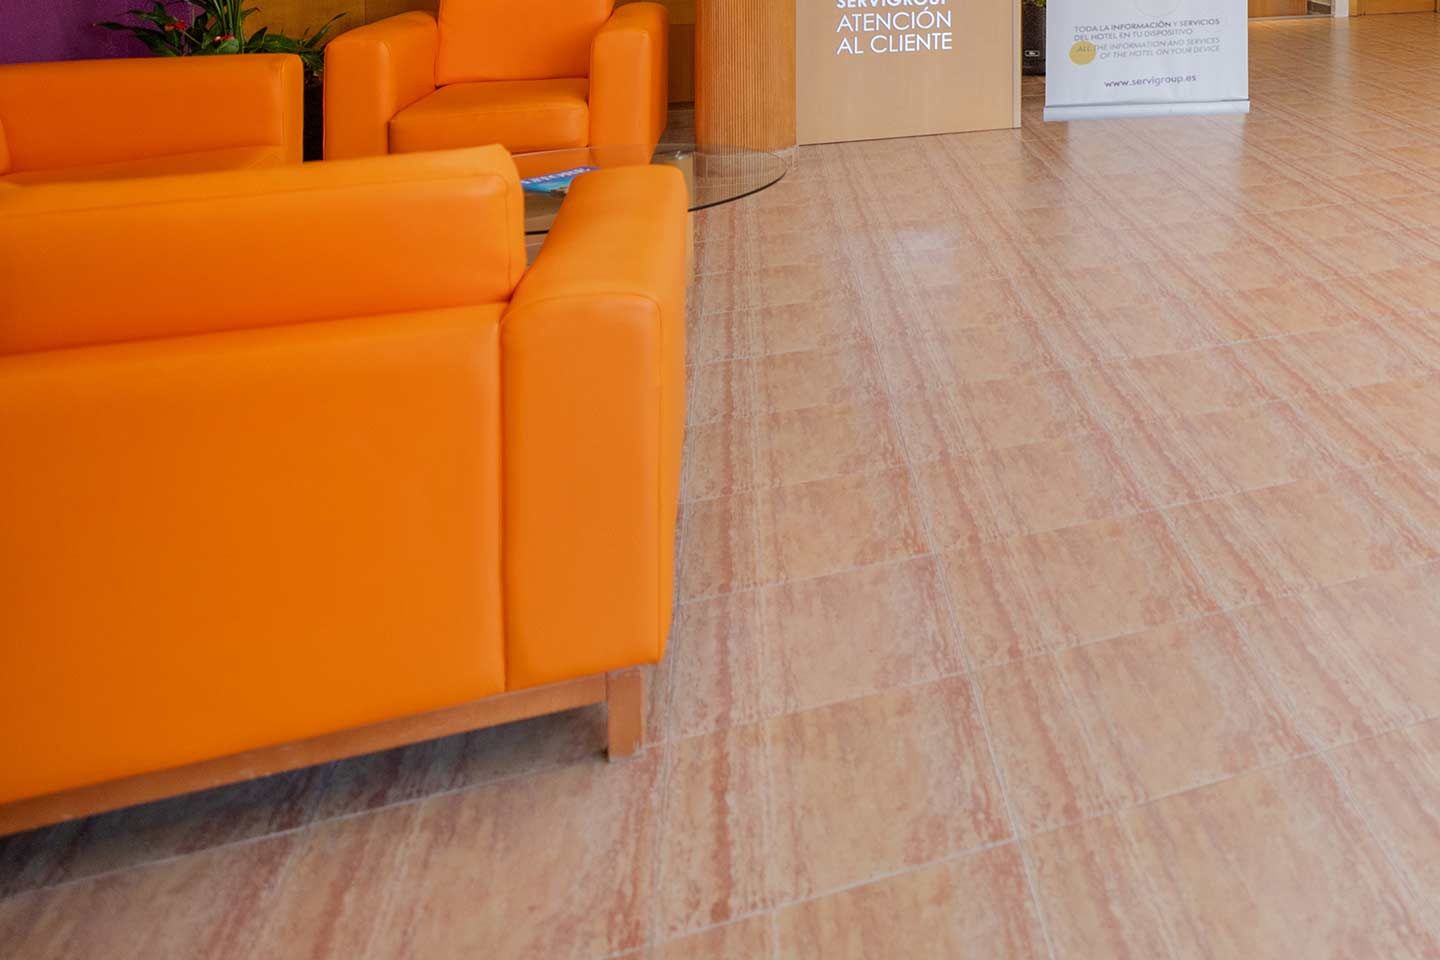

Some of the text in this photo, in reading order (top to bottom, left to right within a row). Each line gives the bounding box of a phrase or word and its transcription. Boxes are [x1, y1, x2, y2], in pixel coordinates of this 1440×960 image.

[836, 6, 952, 33] ATENCIÓN
[1075, 25, 1097, 33] TODA
[1100, 24, 1110, 32] LA
[1111, 21, 1171, 31] INFORMACIÓN
[1179, 18, 1220, 26] SERVICIOS
[1074, 28, 1193, 41] DEL HOTEL EN TU DISPOSITIVO
[836, 32, 953, 55] AL CLIENTE
[1110, 40, 1166, 50] INFORMATION
[1186, 37, 1220, 46] SERVICES
[1129, 49, 1154, 58] HOTEL
[1169, 47, 1192, 55] YOUR
[1193, 45, 1220, 54] DEVICE
[1104, 74, 1197, 88] www.servigroup.es
